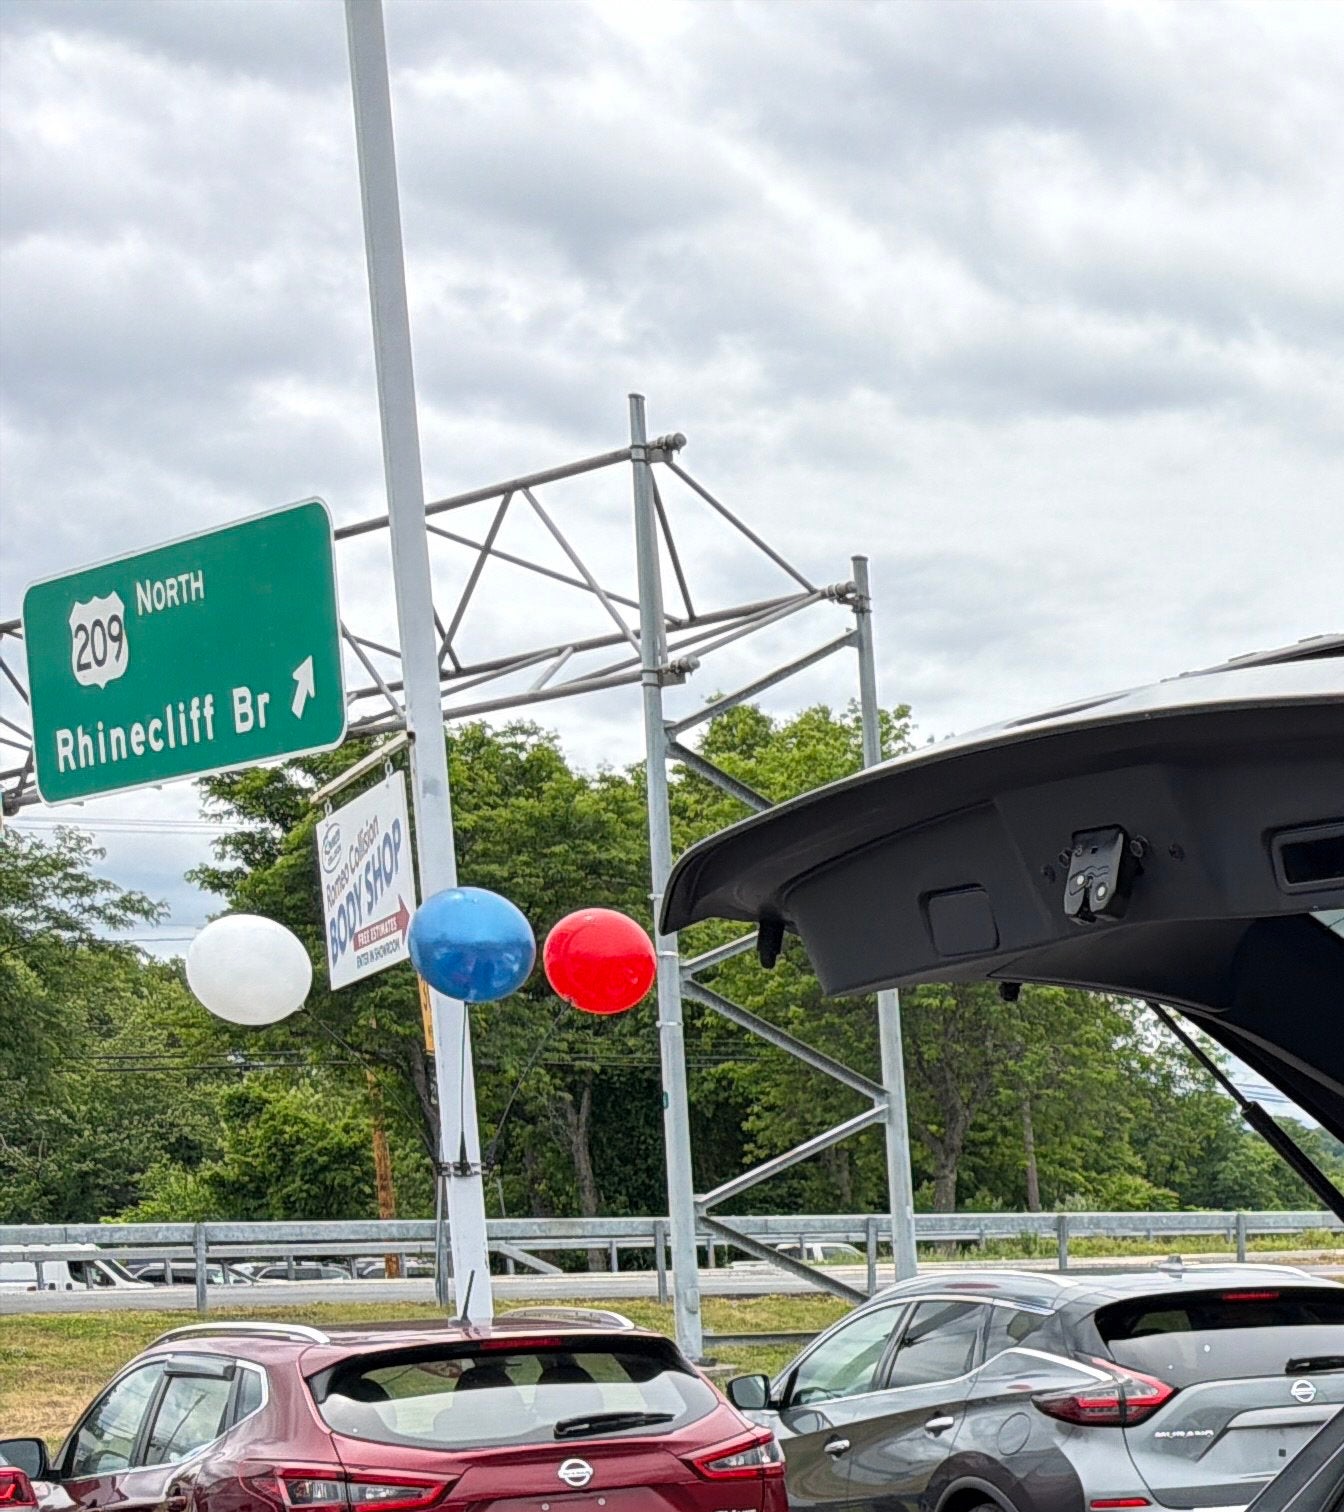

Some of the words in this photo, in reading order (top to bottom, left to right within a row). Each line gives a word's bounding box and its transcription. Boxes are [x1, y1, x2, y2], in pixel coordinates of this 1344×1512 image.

[135, 570, 205, 616] NORTH
[74, 613, 124, 673] 209
[55, 693, 215, 773] Rhinecliff
[231, 686, 270, 734] Br
[326, 862, 350, 909] Romeo
[349, 815, 379, 875] Collision
[329, 873, 363, 969] BODY
[364, 817, 402, 917] SHOP
[357, 928, 370, 948] FREE
[370, 916, 398, 942] ESTIMATES
